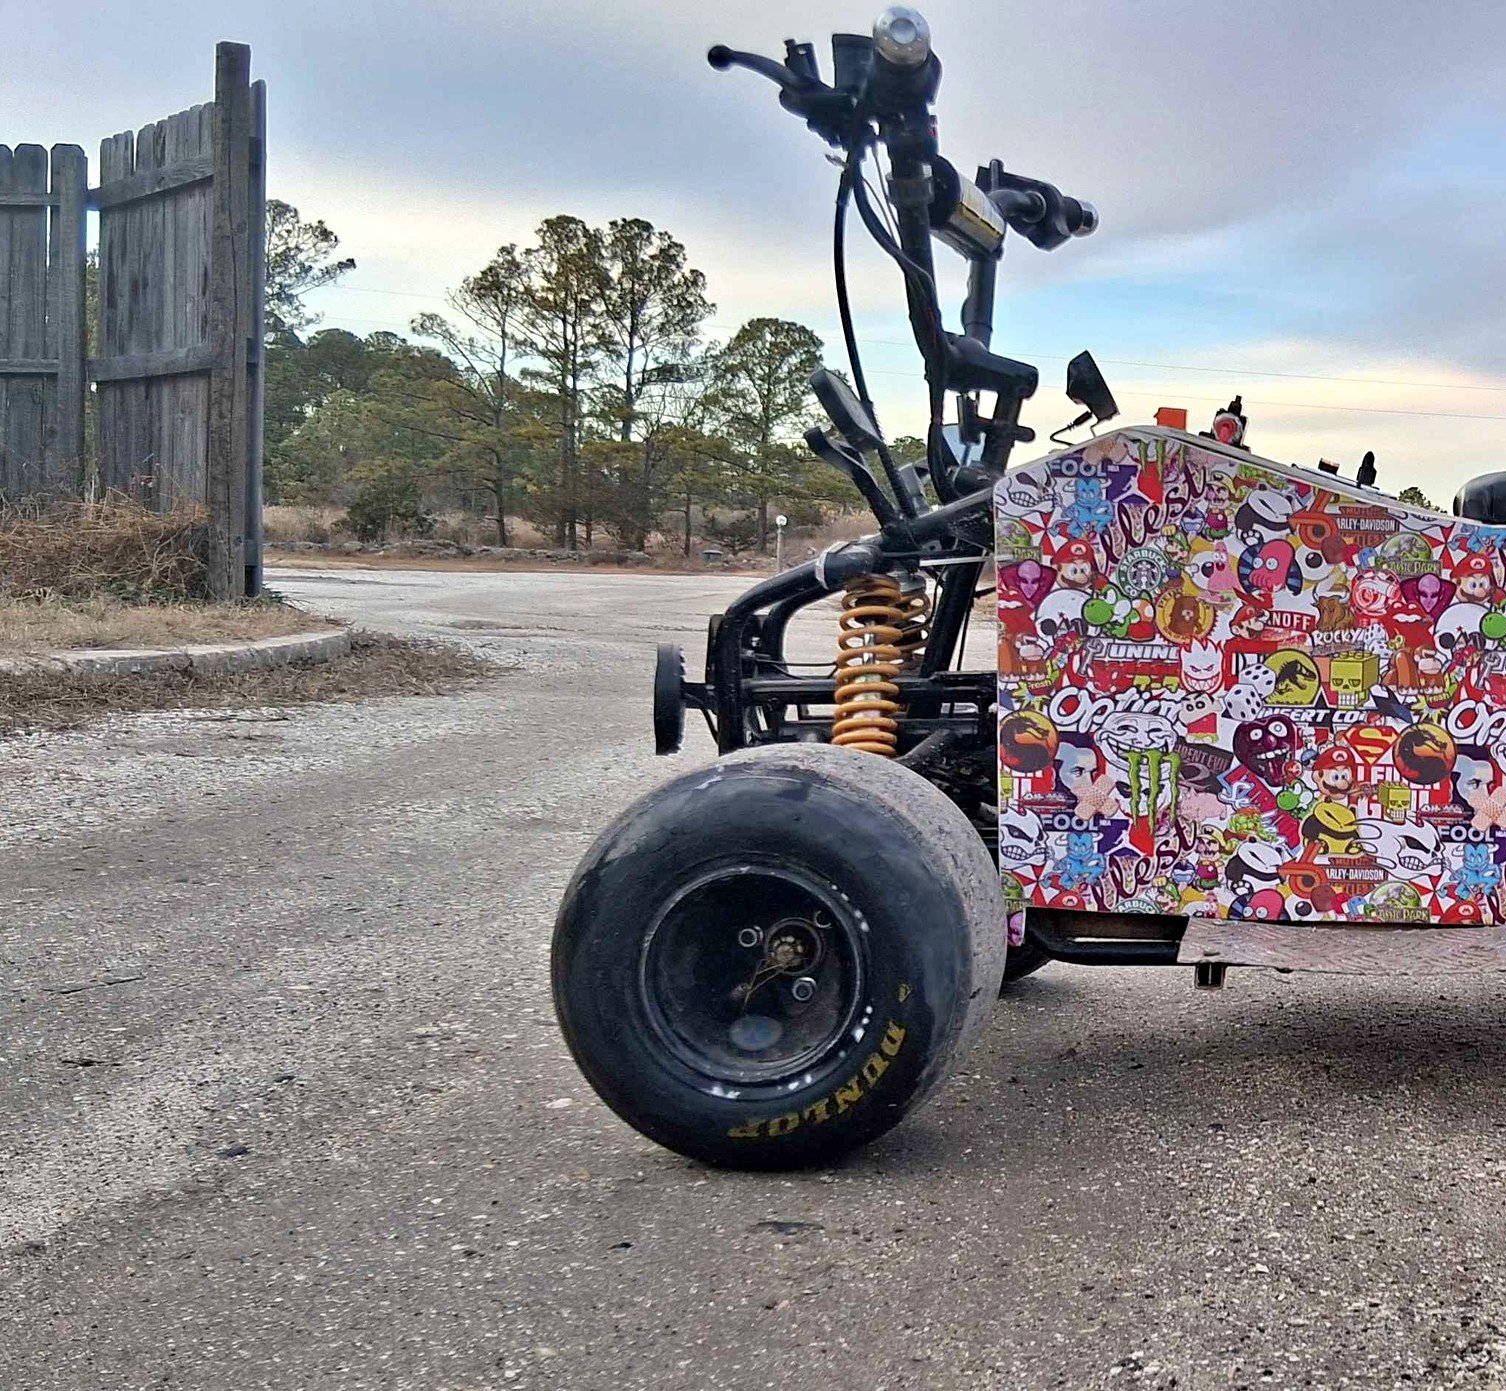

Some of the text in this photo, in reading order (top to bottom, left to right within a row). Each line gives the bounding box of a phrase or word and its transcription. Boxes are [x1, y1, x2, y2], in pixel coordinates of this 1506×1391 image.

[1337, 518, 1396, 532] ARLEY-DAVIDSON
[1269, 611, 1311, 631] NOFF
[1332, 709, 1367, 722] COI
[1041, 814, 1098, 831] FOOL
[1437, 825, 1494, 842] FOOL
[1326, 868, 1384, 881] ARLEY-DAVIDSON
[727, 1019, 906, 1138] DUNLOP
